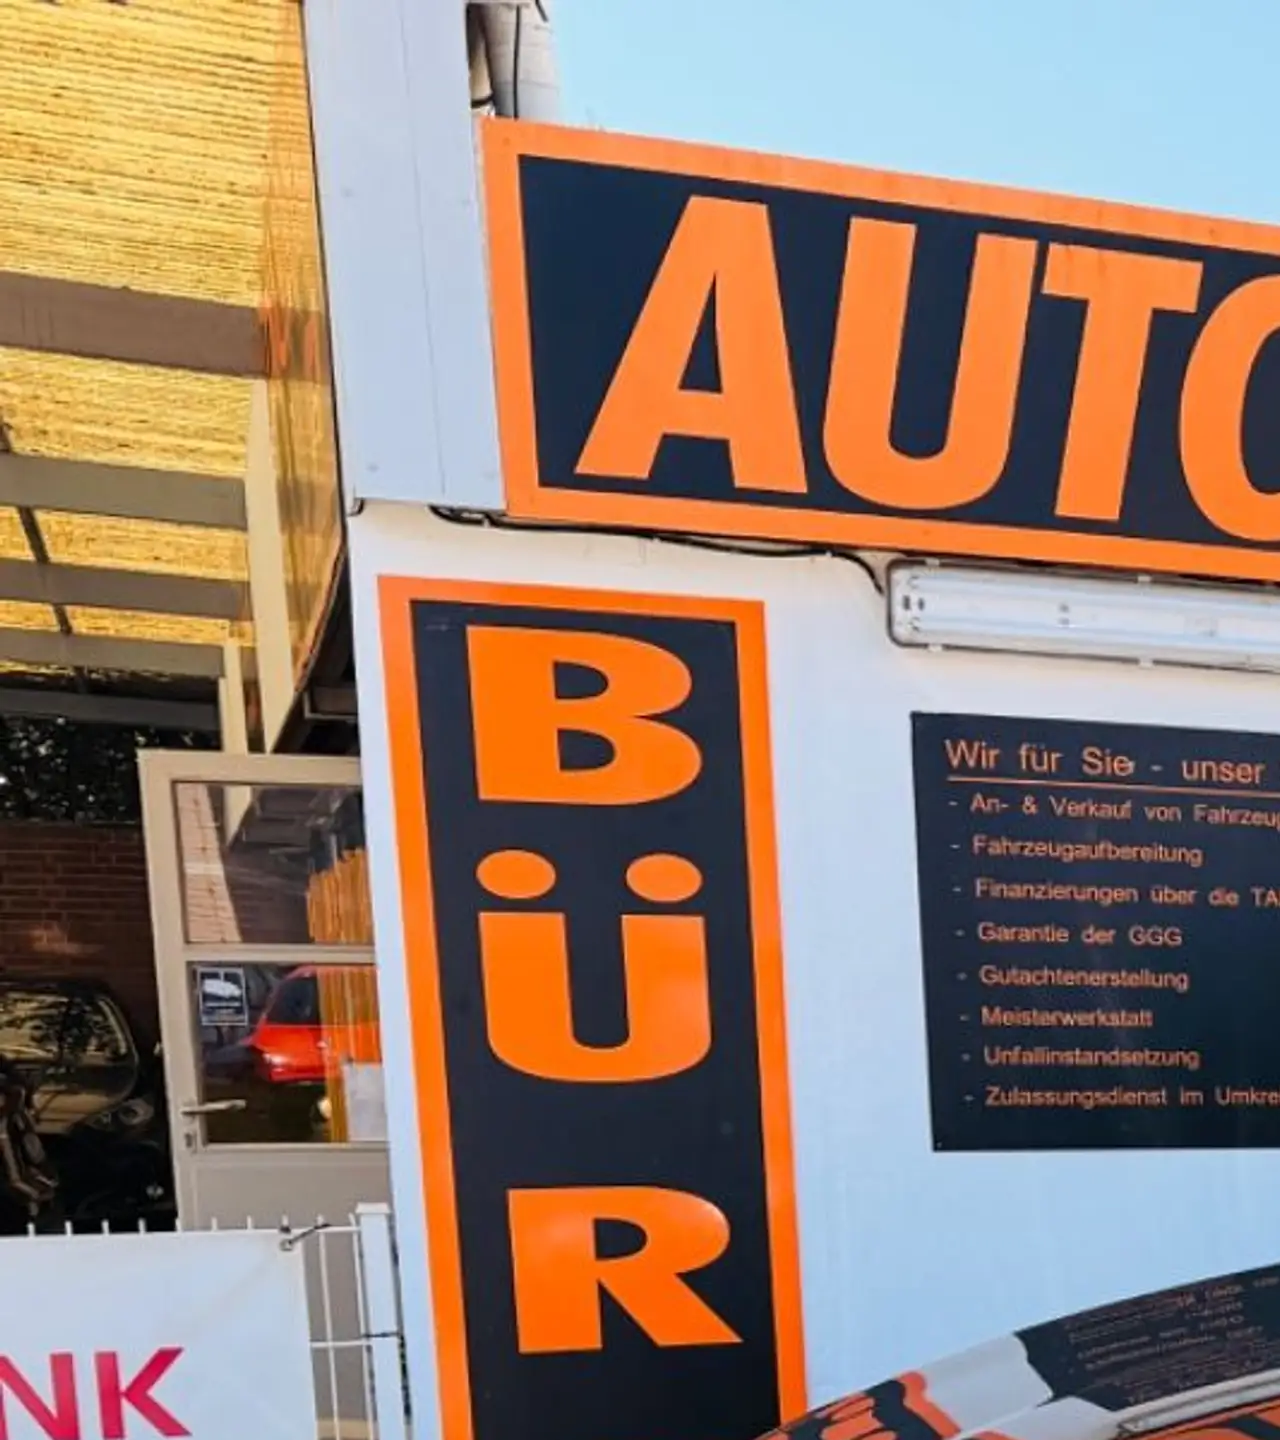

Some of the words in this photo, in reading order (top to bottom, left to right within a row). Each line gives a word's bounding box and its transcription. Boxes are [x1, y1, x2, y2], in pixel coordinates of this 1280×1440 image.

[944, 738, 1001, 769] Wir
[1020, 742, 1064, 773] für
[1081, 745, 1136, 778] Sie
[1181, 758, 1266, 785] unser
[969, 792, 1010, 813] An-
[1021, 794, 1040, 815] &
[1048, 795, 1133, 820] Verkauf
[1143, 804, 1183, 823] von
[972, 833, 1205, 868] Fahrzeugaufbereitung
[974, 877, 1140, 908] Finanzierungen
[1150, 883, 1199, 906] über
[1207, 885, 1240, 907] die
[977, 921, 1071, 943] Garantie
[1080, 924, 1117, 945] der
[1127, 924, 1184, 947] GGG
[978, 964, 1190, 993] Gutachtenerstellung
[980, 1005, 1154, 1028] Meisterwerkstatt
[983, 1045, 1201, 1070] Unfallinstandsetzung
[984, 1084, 1169, 1110] Zulassungsdienst
[1180, 1085, 1204, 1106] im
